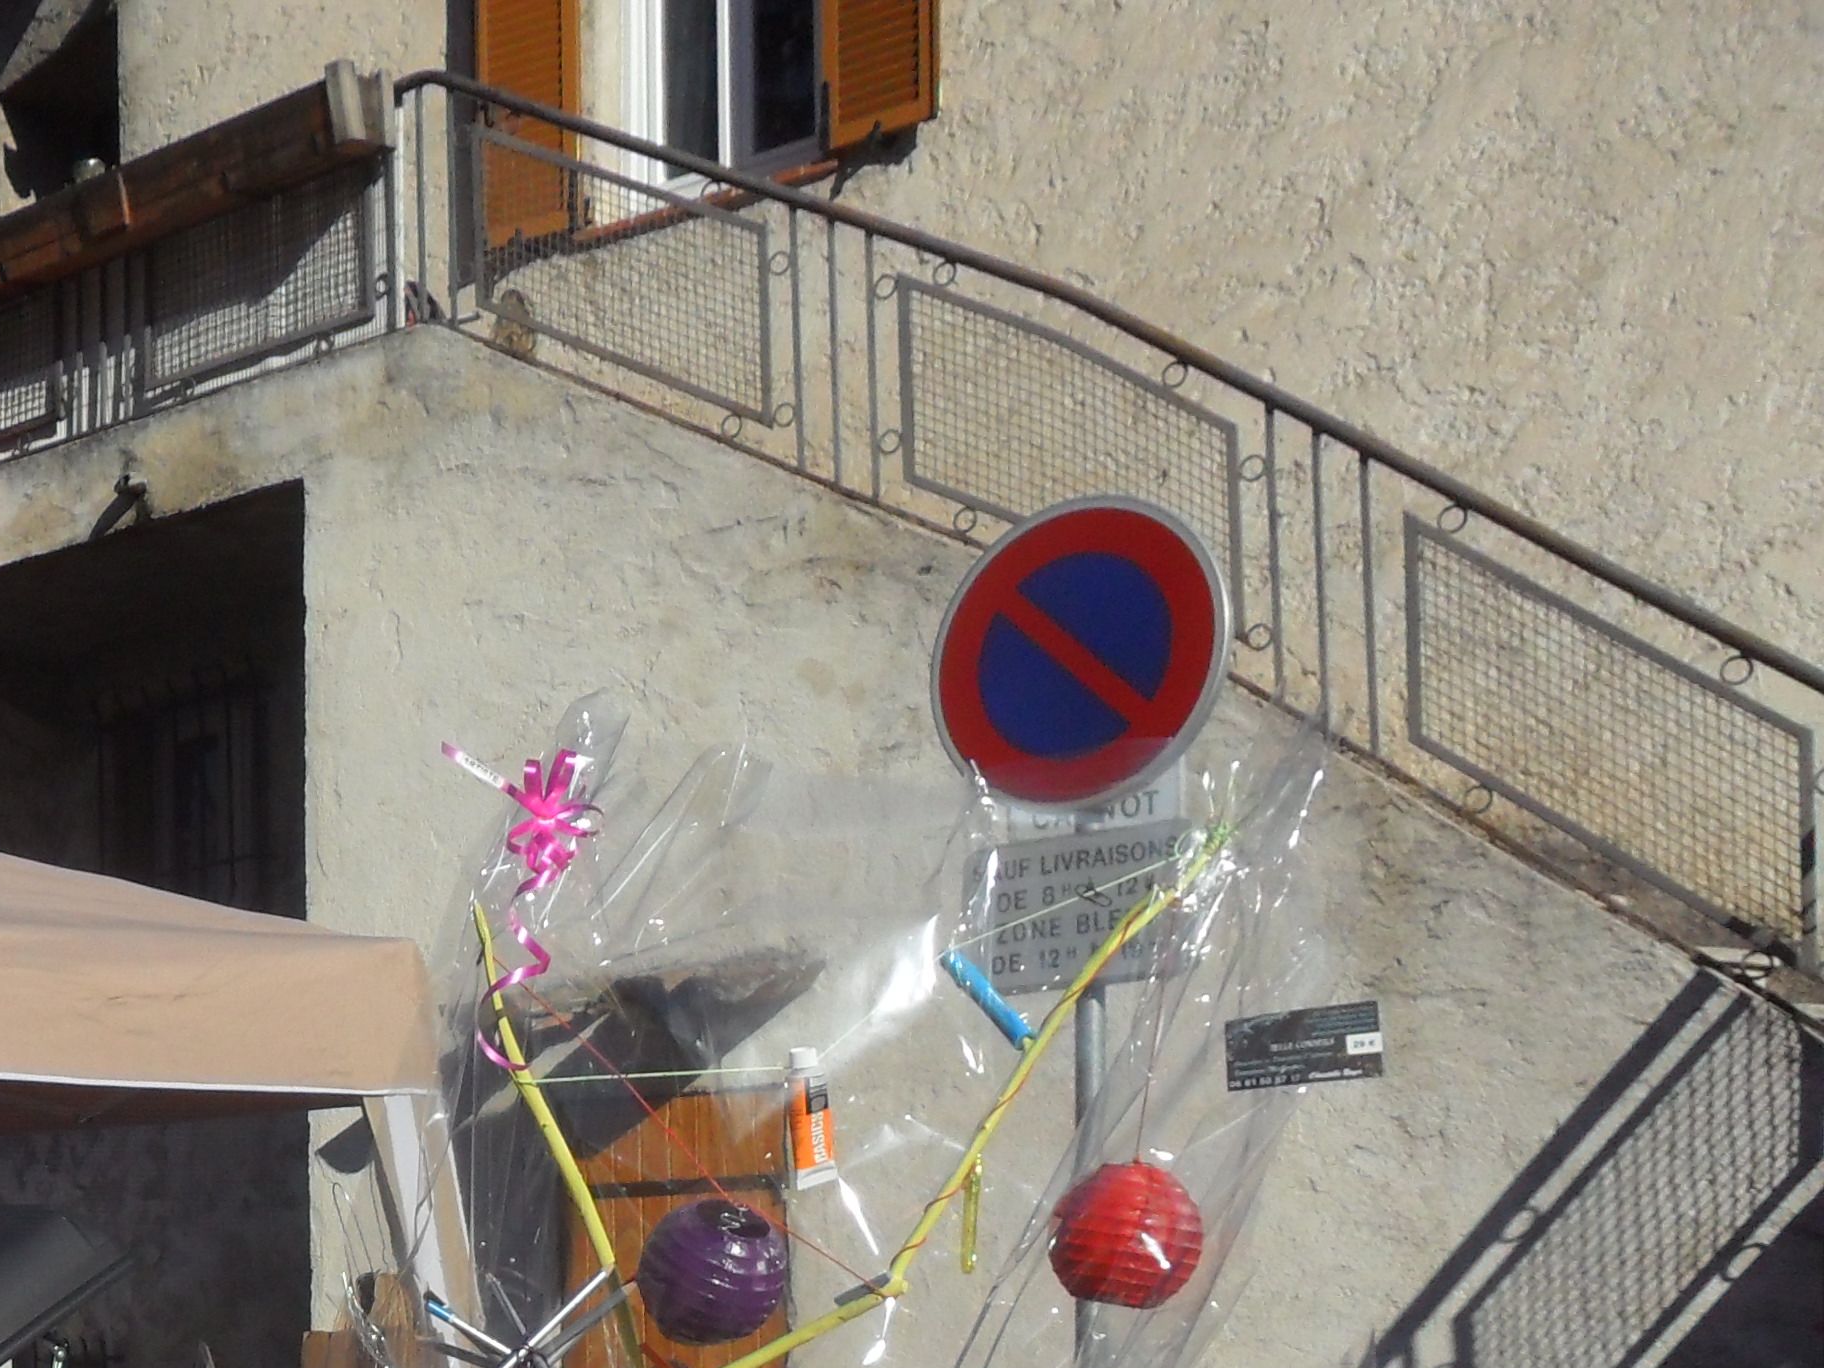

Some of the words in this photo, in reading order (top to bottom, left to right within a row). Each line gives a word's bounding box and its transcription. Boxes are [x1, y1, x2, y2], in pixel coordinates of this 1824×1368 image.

[1040, 835, 1178, 876] LIVRAISONS
[996, 891, 1027, 913] DE
[995, 917, 1062, 945] ZONE
[992, 953, 1023, 975] DE
[810, 1111, 829, 1164] BASICS
